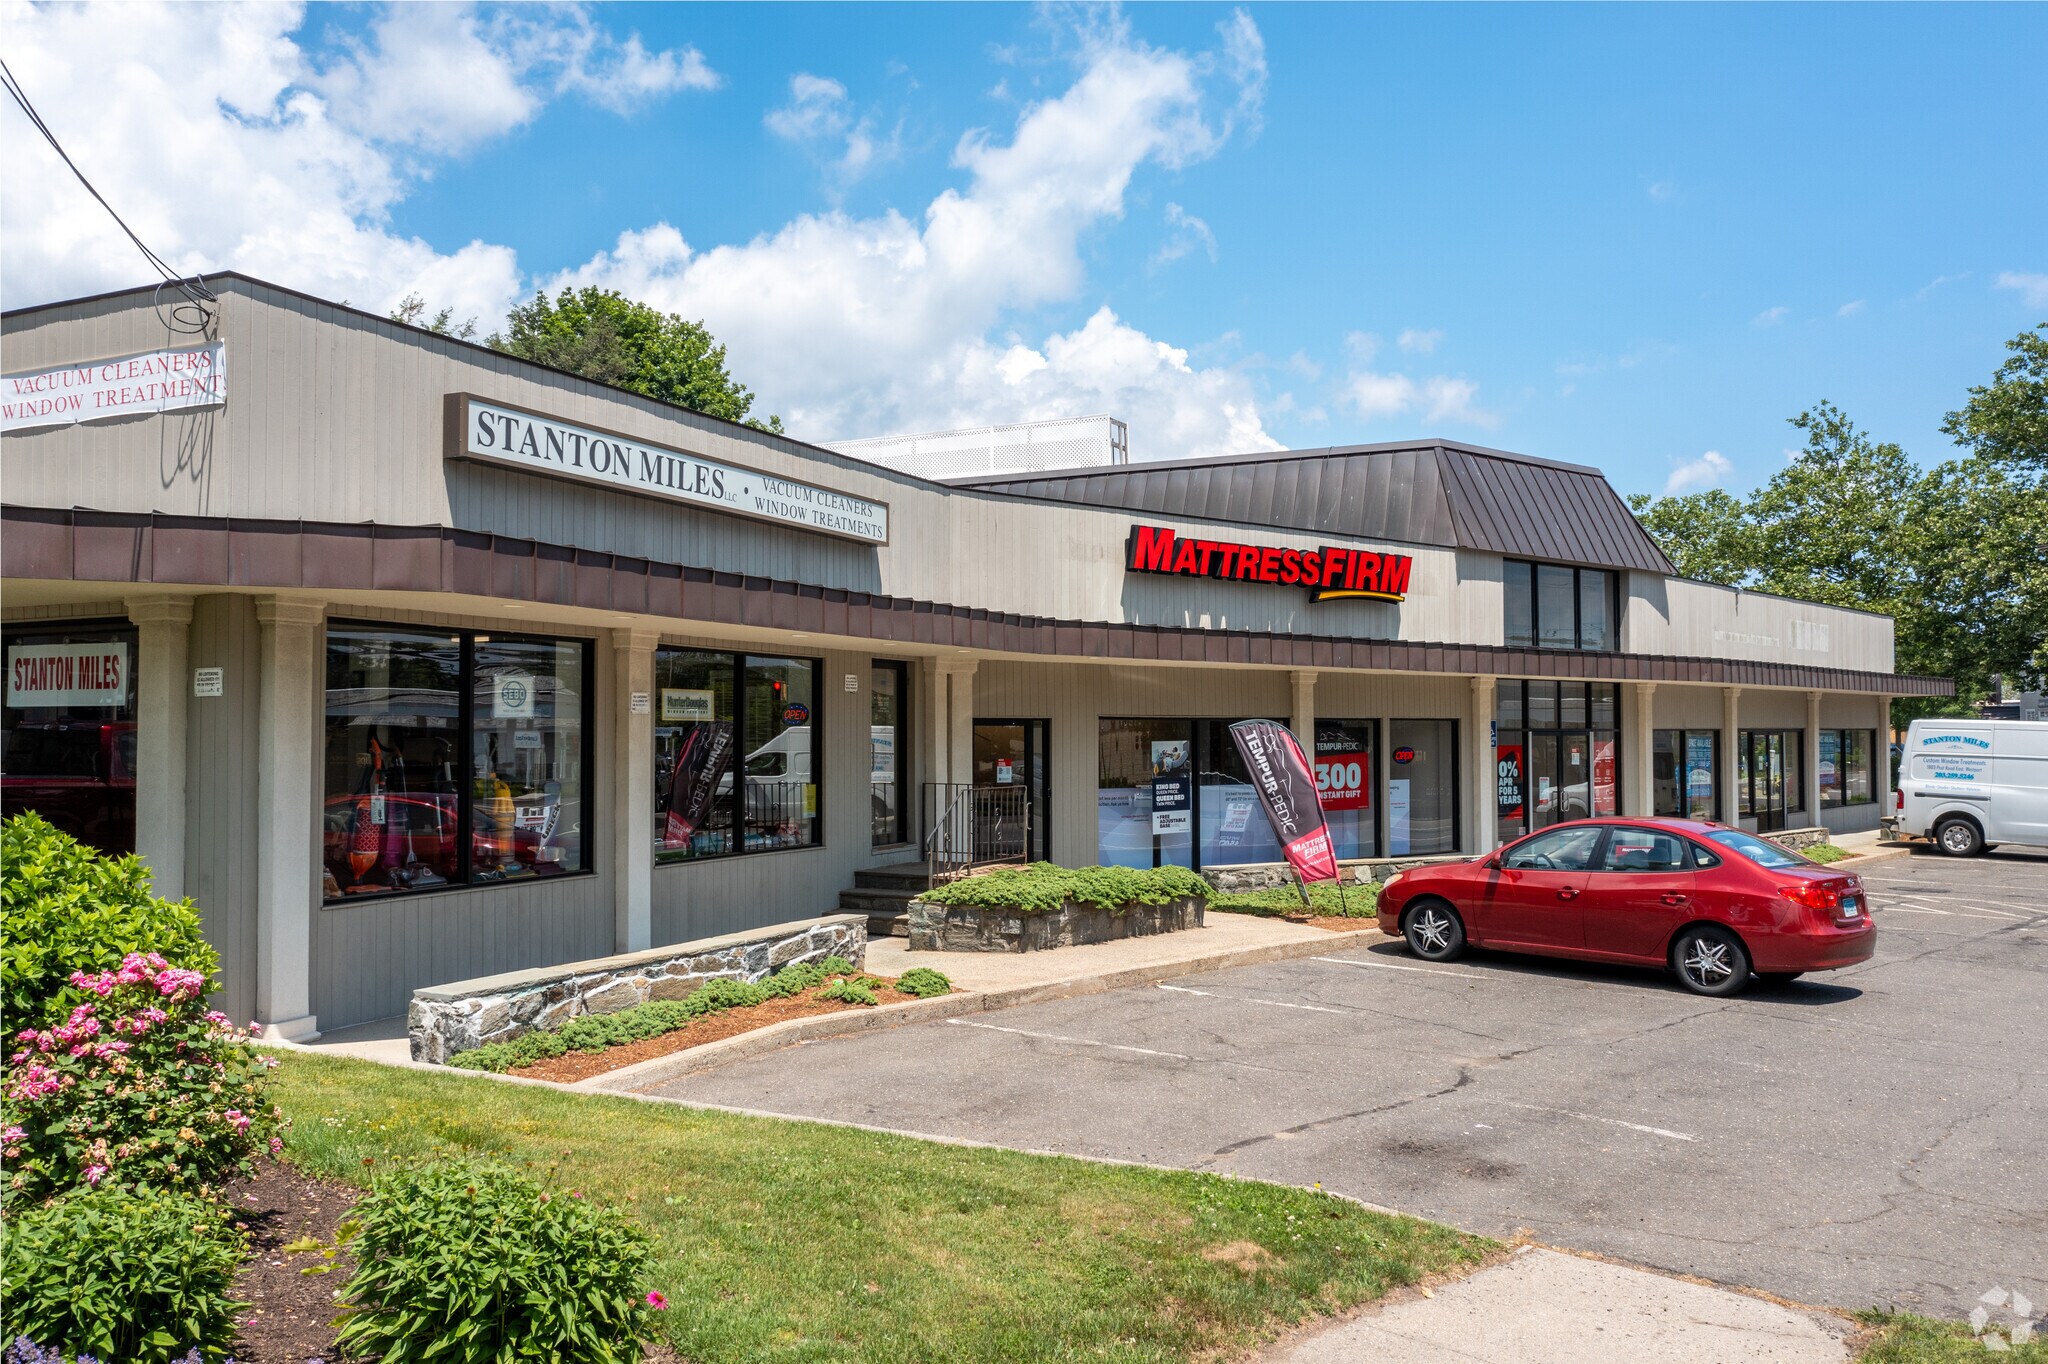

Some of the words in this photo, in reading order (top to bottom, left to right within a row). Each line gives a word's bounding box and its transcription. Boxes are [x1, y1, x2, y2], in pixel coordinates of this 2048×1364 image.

[14, 368, 93, 395] VACUUM
[102, 350, 212, 382] CLEANERS
[2, 394, 84, 420] WINDOW
[93, 374, 226, 408] TREATMENT
[477, 410, 631, 478] STANTON
[639, 450, 724, 499] MILES
[724, 491, 737, 502] LLC
[762, 478, 812, 502] VACUUM
[816, 492, 873, 517] CLEANERS
[754, 496, 807, 520] WINDOW
[812, 510, 883, 539] TREATMENTS
[14, 656, 74, 691] STANTON
[78, 654, 120, 690] MILES
[503, 688, 526, 699] SEBO
[667, 696, 708, 708] HunterDouglas
[784, 710, 808, 720] OPEN
[1316, 742, 1358, 750] TEMPUR-PEDIC
[1923, 736, 1962, 746] STANTON
[1963, 737, 1990, 749] MILES
[1395, 752, 1414, 760] OPEN
[1498, 760, 1518, 777] 0%
[1498, 778, 1513, 786] APR
[1320, 790, 1344, 800] NSTANT
[1345, 790, 1361, 798] GIFT
[1498, 786, 1512, 795] FOR
[1498, 795, 1522, 804] YEARS
[1292, 834, 1326, 853] MATTRE
[1304, 842, 1328, 858] FIRM
